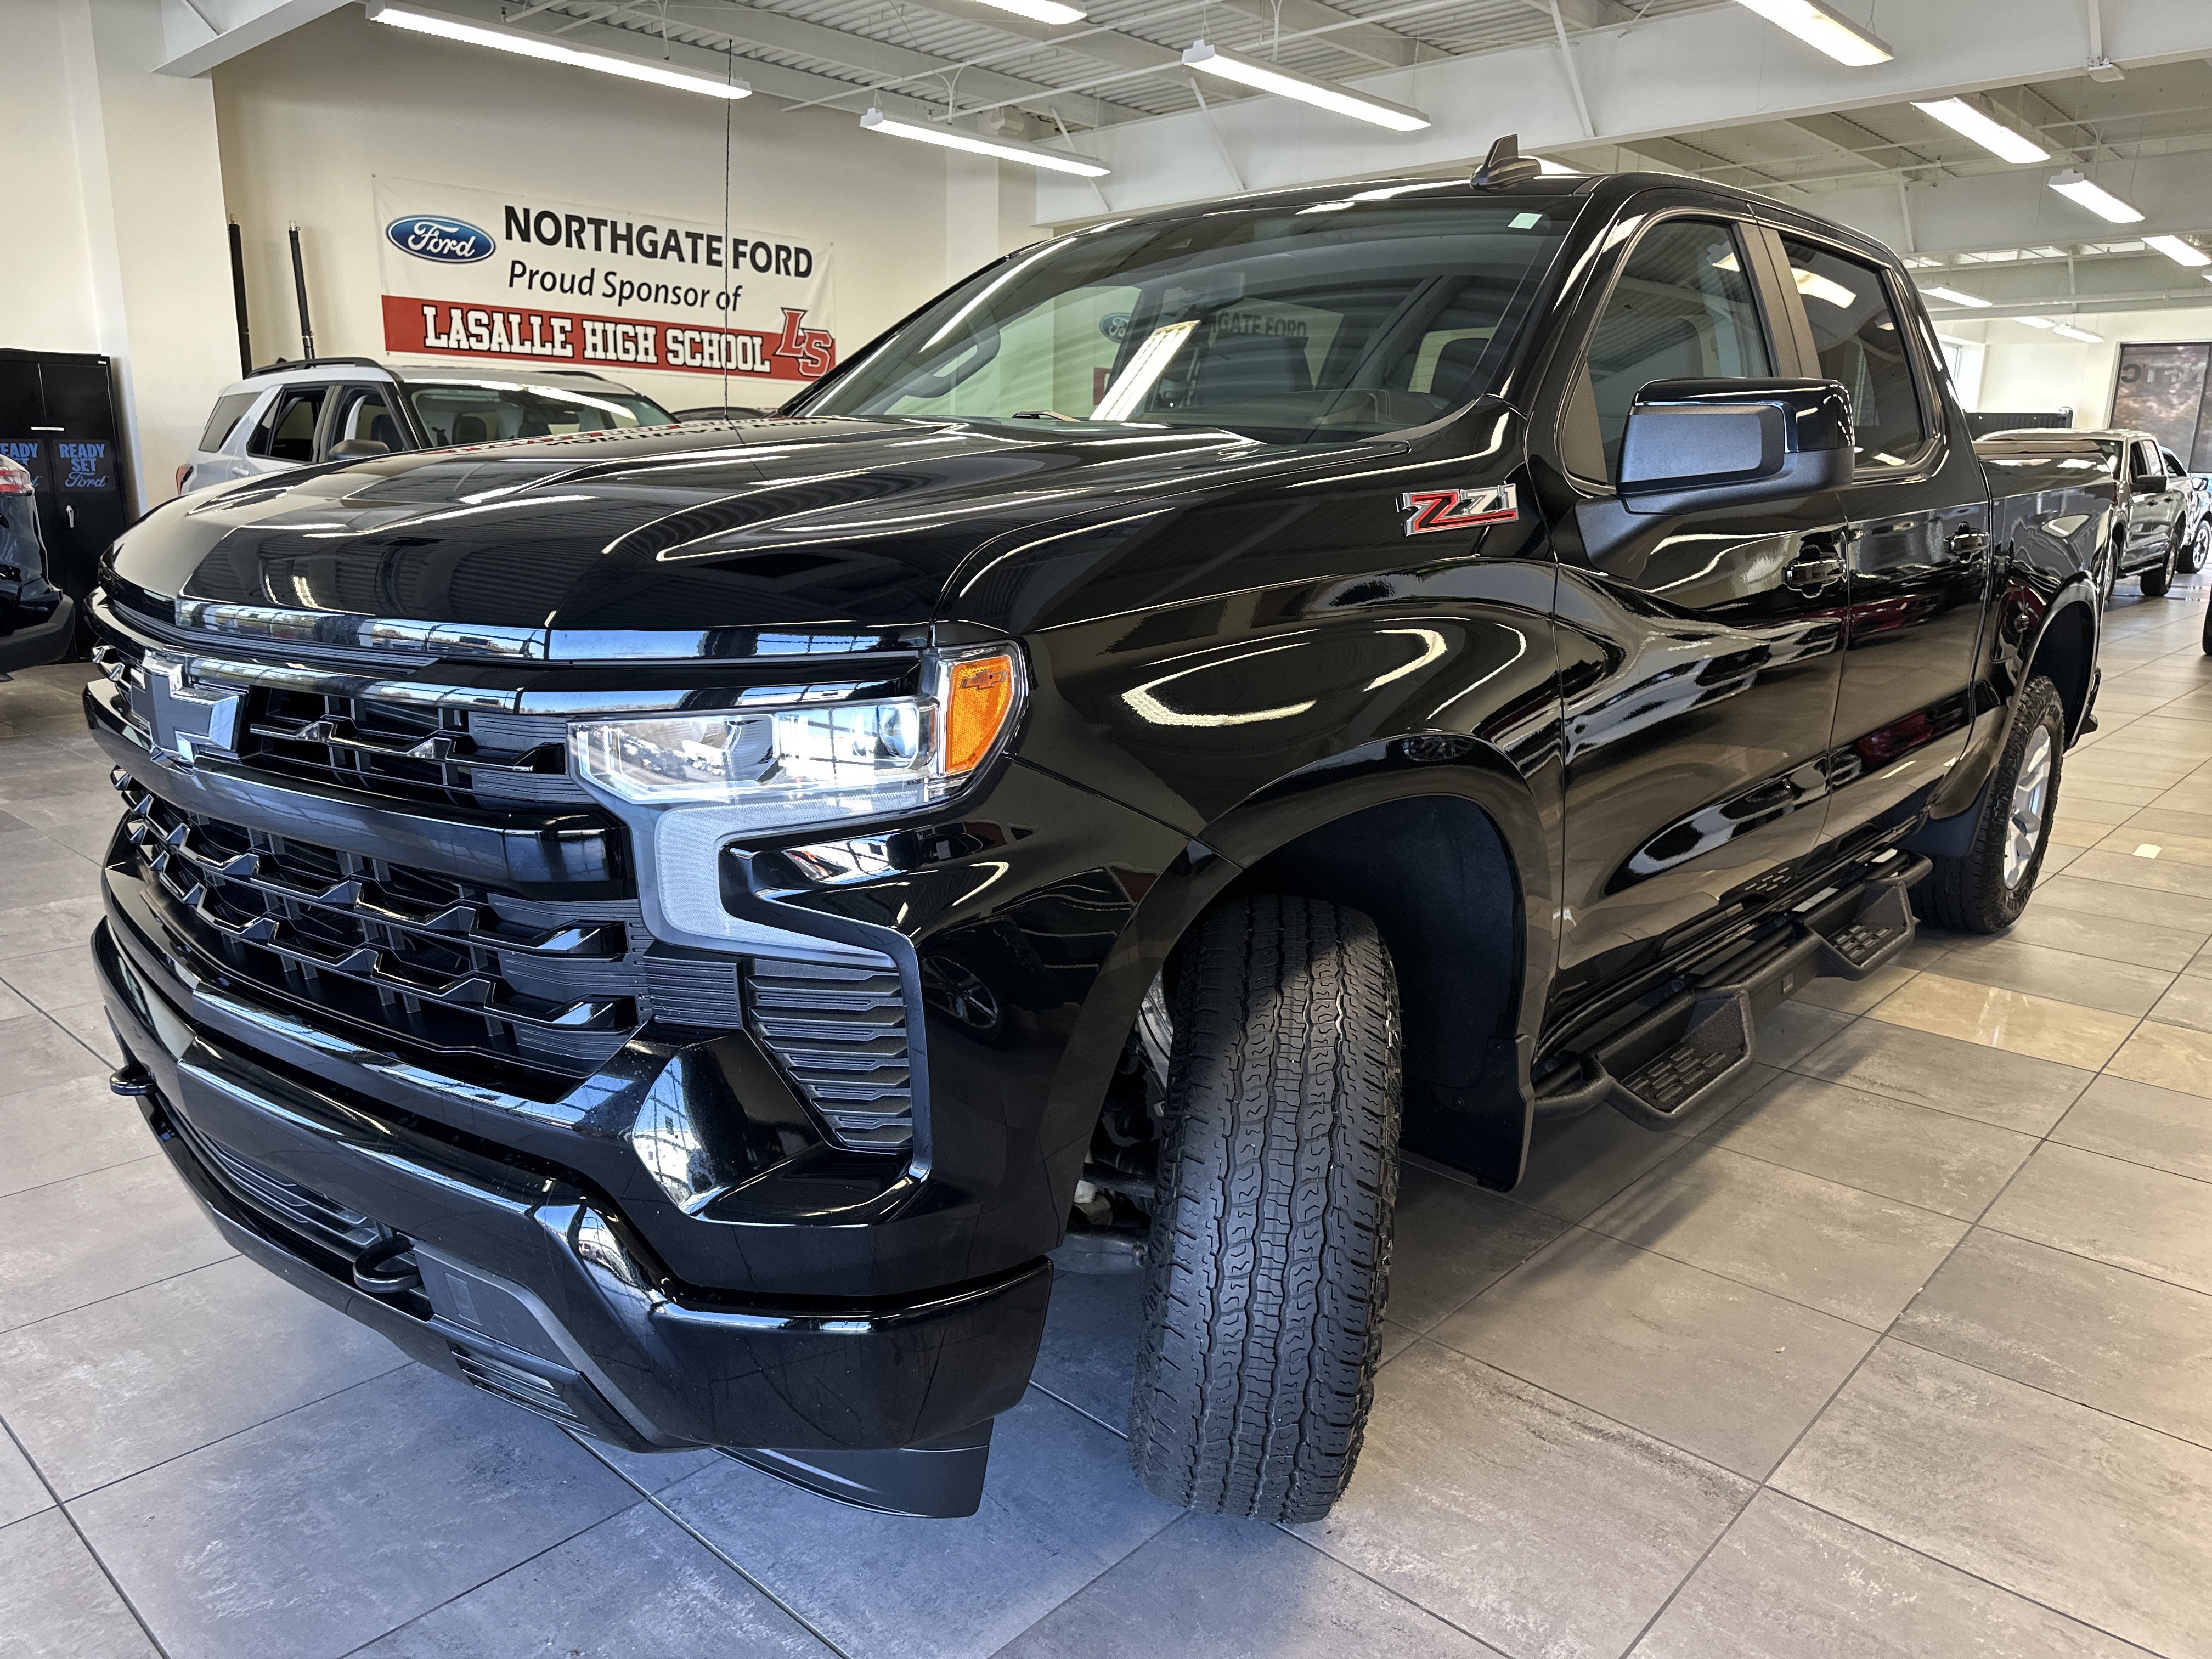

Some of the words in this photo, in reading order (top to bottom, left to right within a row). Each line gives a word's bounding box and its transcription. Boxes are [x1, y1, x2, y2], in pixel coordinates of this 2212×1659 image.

[408, 221, 476, 258] Ford
[505, 205, 723, 268] NORTHGATE
[732, 238, 813, 279] FORD
[508, 259, 594, 297] Proud
[602, 270, 712, 308] Sponsor
[715, 285, 743, 312] of
[421, 304, 574, 357] LASALLE
[582, 319, 658, 364] HIGH
[665, 328, 771, 374] SCHOOL
[773, 307, 833, 377] LS
[0, 443, 38, 458] EADY
[59, 443, 105, 458] READY
[71, 458, 97, 472] SET
[65, 472, 106, 488] Ford
[1396, 483, 1520, 537] Z71
